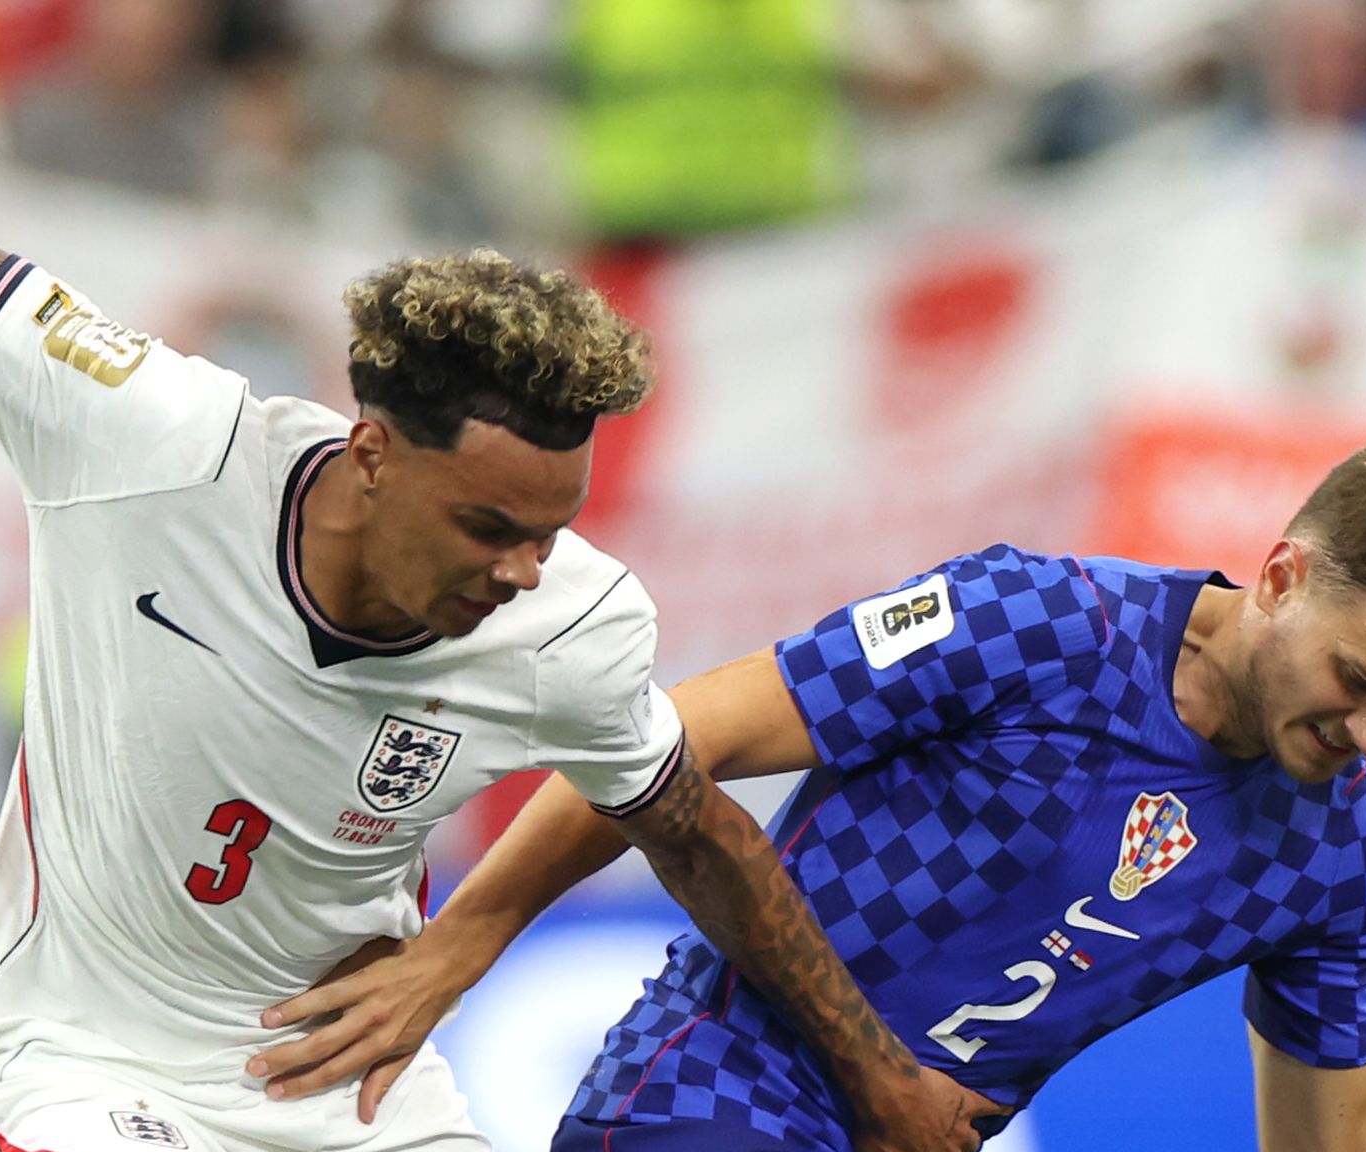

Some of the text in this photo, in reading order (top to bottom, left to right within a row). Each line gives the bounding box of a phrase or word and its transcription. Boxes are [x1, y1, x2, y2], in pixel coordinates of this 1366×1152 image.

[184, 798, 273, 905] 3
[338, 810, 397, 833] CROATIA
[925, 960, 1057, 1063] 2
